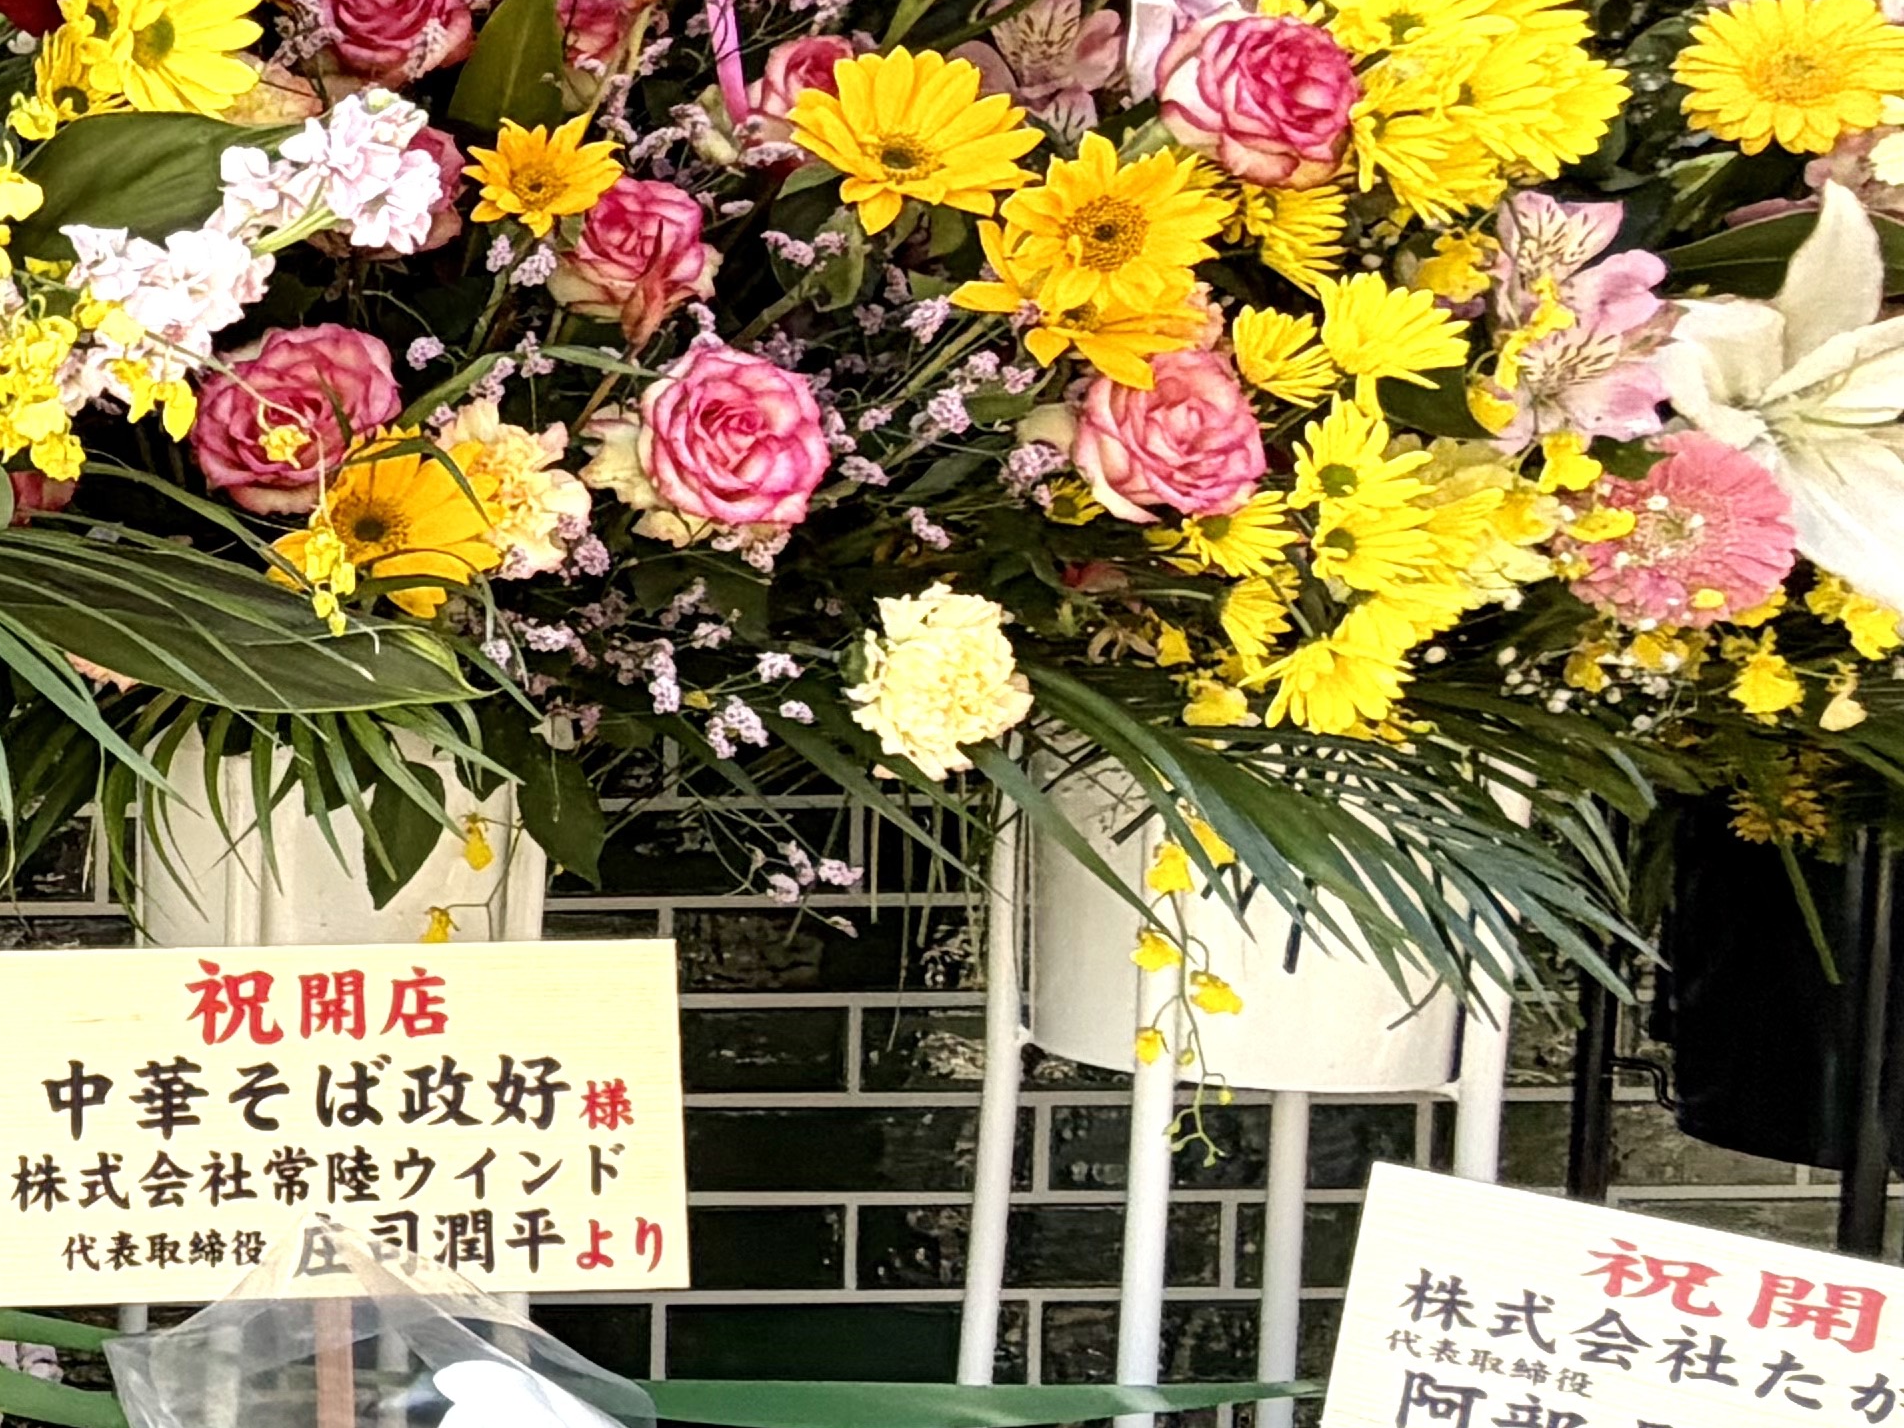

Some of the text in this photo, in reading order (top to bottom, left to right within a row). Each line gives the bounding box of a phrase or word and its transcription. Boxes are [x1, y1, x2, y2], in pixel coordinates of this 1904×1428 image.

[185, 958, 450, 1046] 祝開店
[9, 1141, 625, 1213] 株式会社常陸ウインド
[61, 1228, 267, 1273] 代表取締役
[1580, 1237, 1888, 1354] 祝開
[1385, 1328, 1595, 1399] 代表取締役
